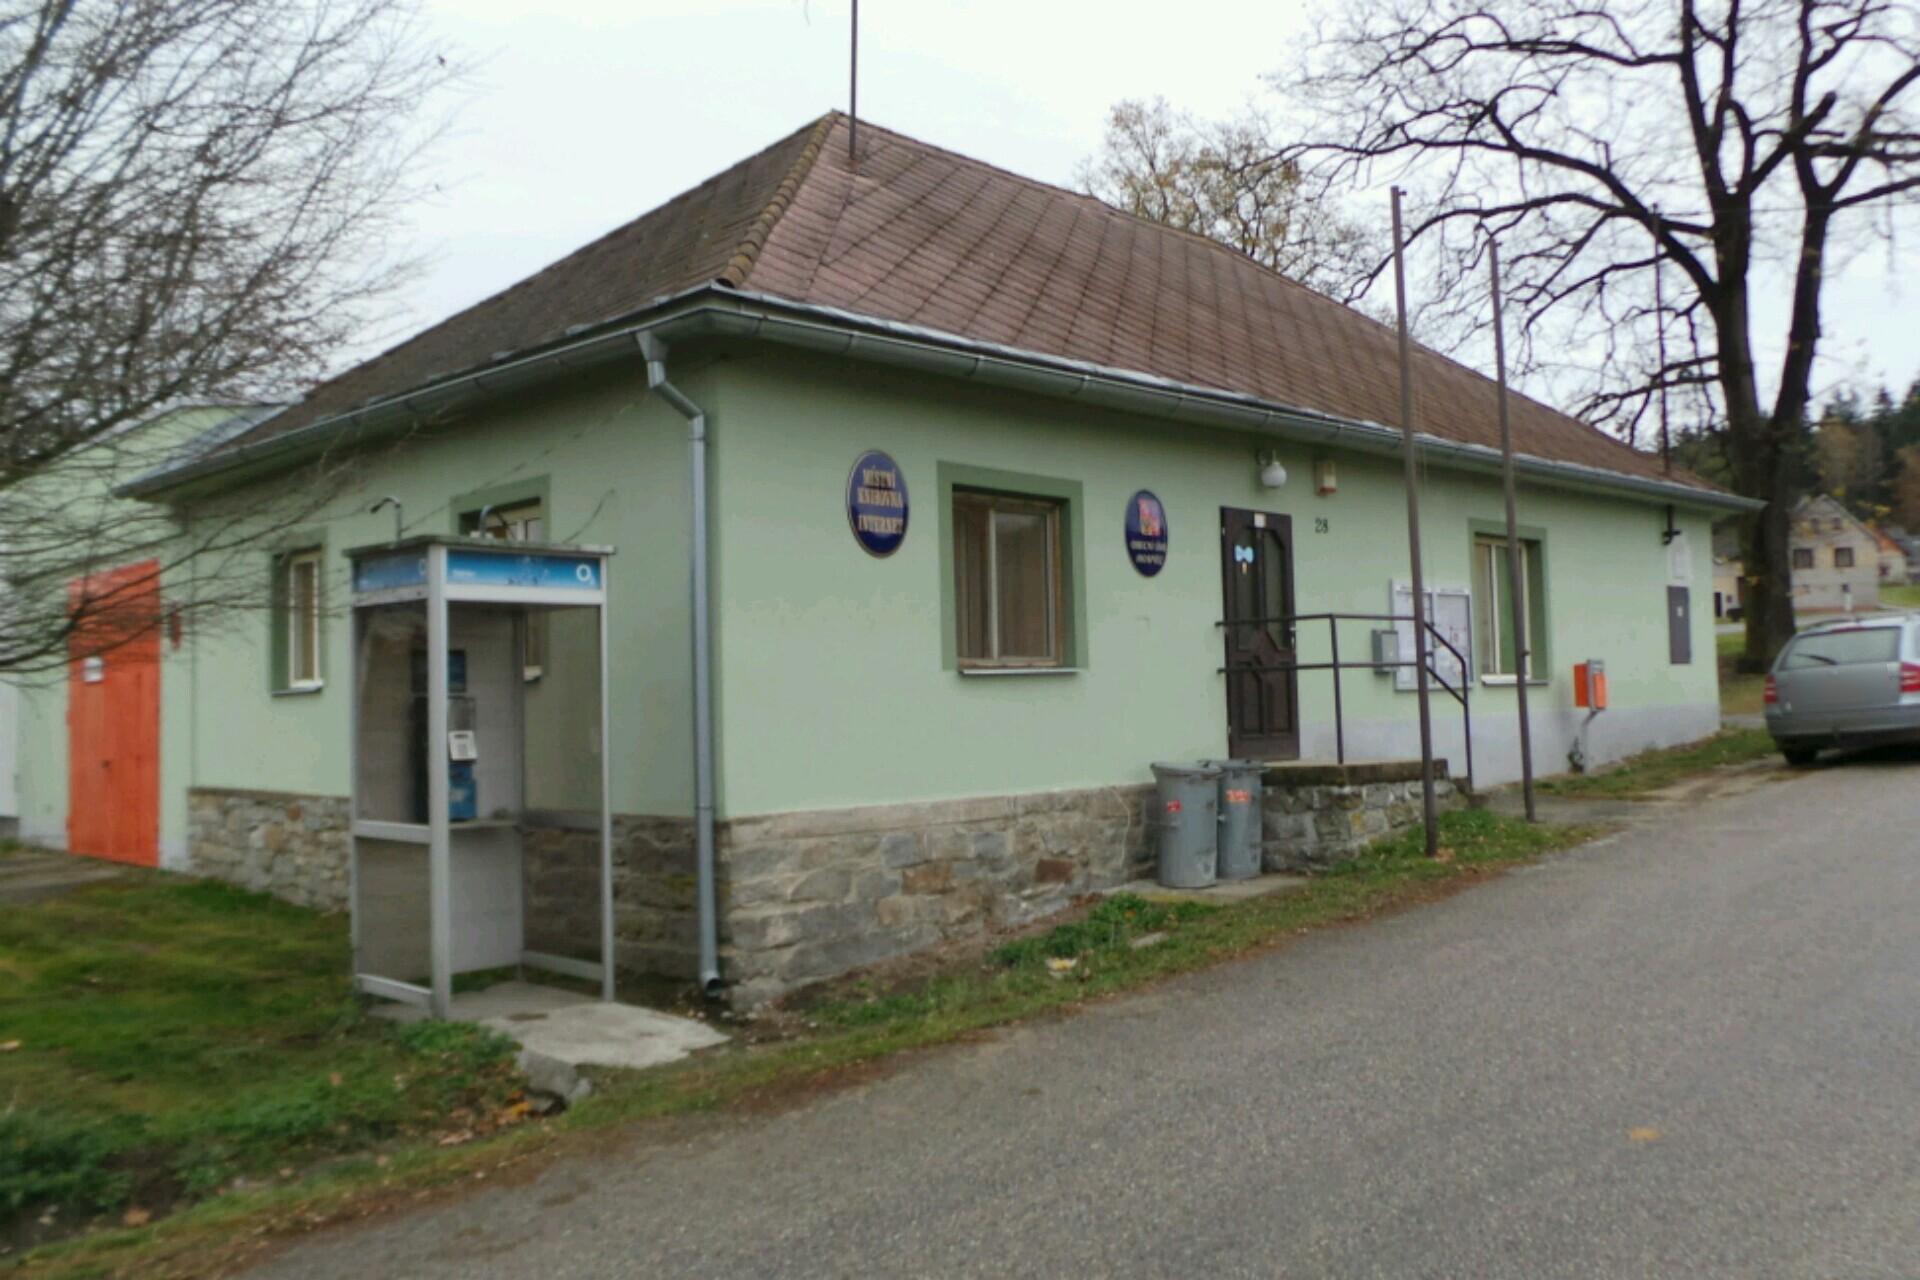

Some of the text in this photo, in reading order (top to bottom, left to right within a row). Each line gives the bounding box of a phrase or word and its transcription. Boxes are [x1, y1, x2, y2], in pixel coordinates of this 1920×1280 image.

[863, 465, 896, 488] MÍSTNÍ
[857, 487, 904, 508] KNIHOVNA
[858, 514, 904, 534] INTERNET
